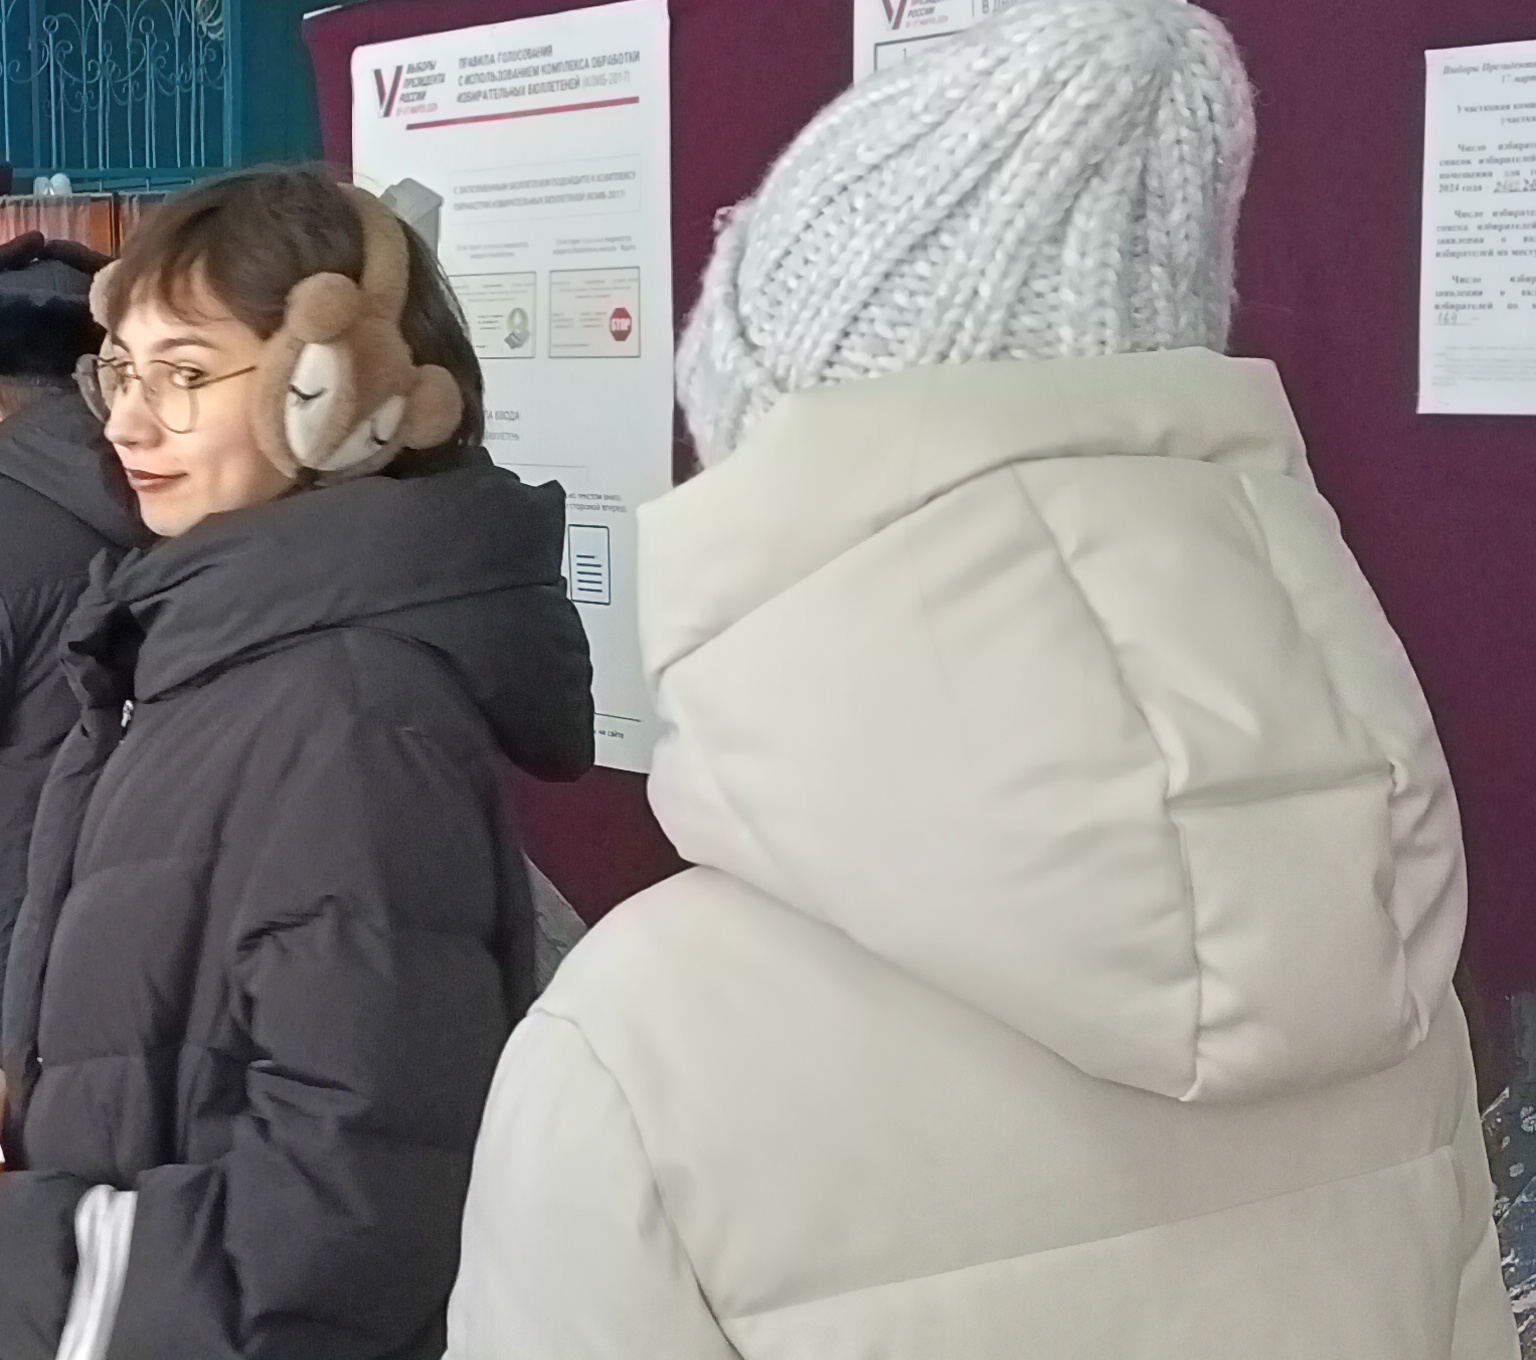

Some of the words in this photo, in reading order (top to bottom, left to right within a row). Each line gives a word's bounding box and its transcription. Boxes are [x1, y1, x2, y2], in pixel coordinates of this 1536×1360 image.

[457, 74, 463, 87] С
[464, 65, 539, 85] ИСПОЛЬЗОВАНИЕМ
[541, 58, 590, 76] КОМПЛЕКСА
[591, 50, 640, 68] ОБРАБОТКИ
[458, 53, 495, 69] ПРАВИЛА
[497, 44, 553, 64] ГОЛОСОВАНИЯ
[456, 85, 526, 103] ИЗБИРАТЕЛЬНЫХ
[527, 74, 581, 95] БЮЛЛЕТЕНЕЙ
